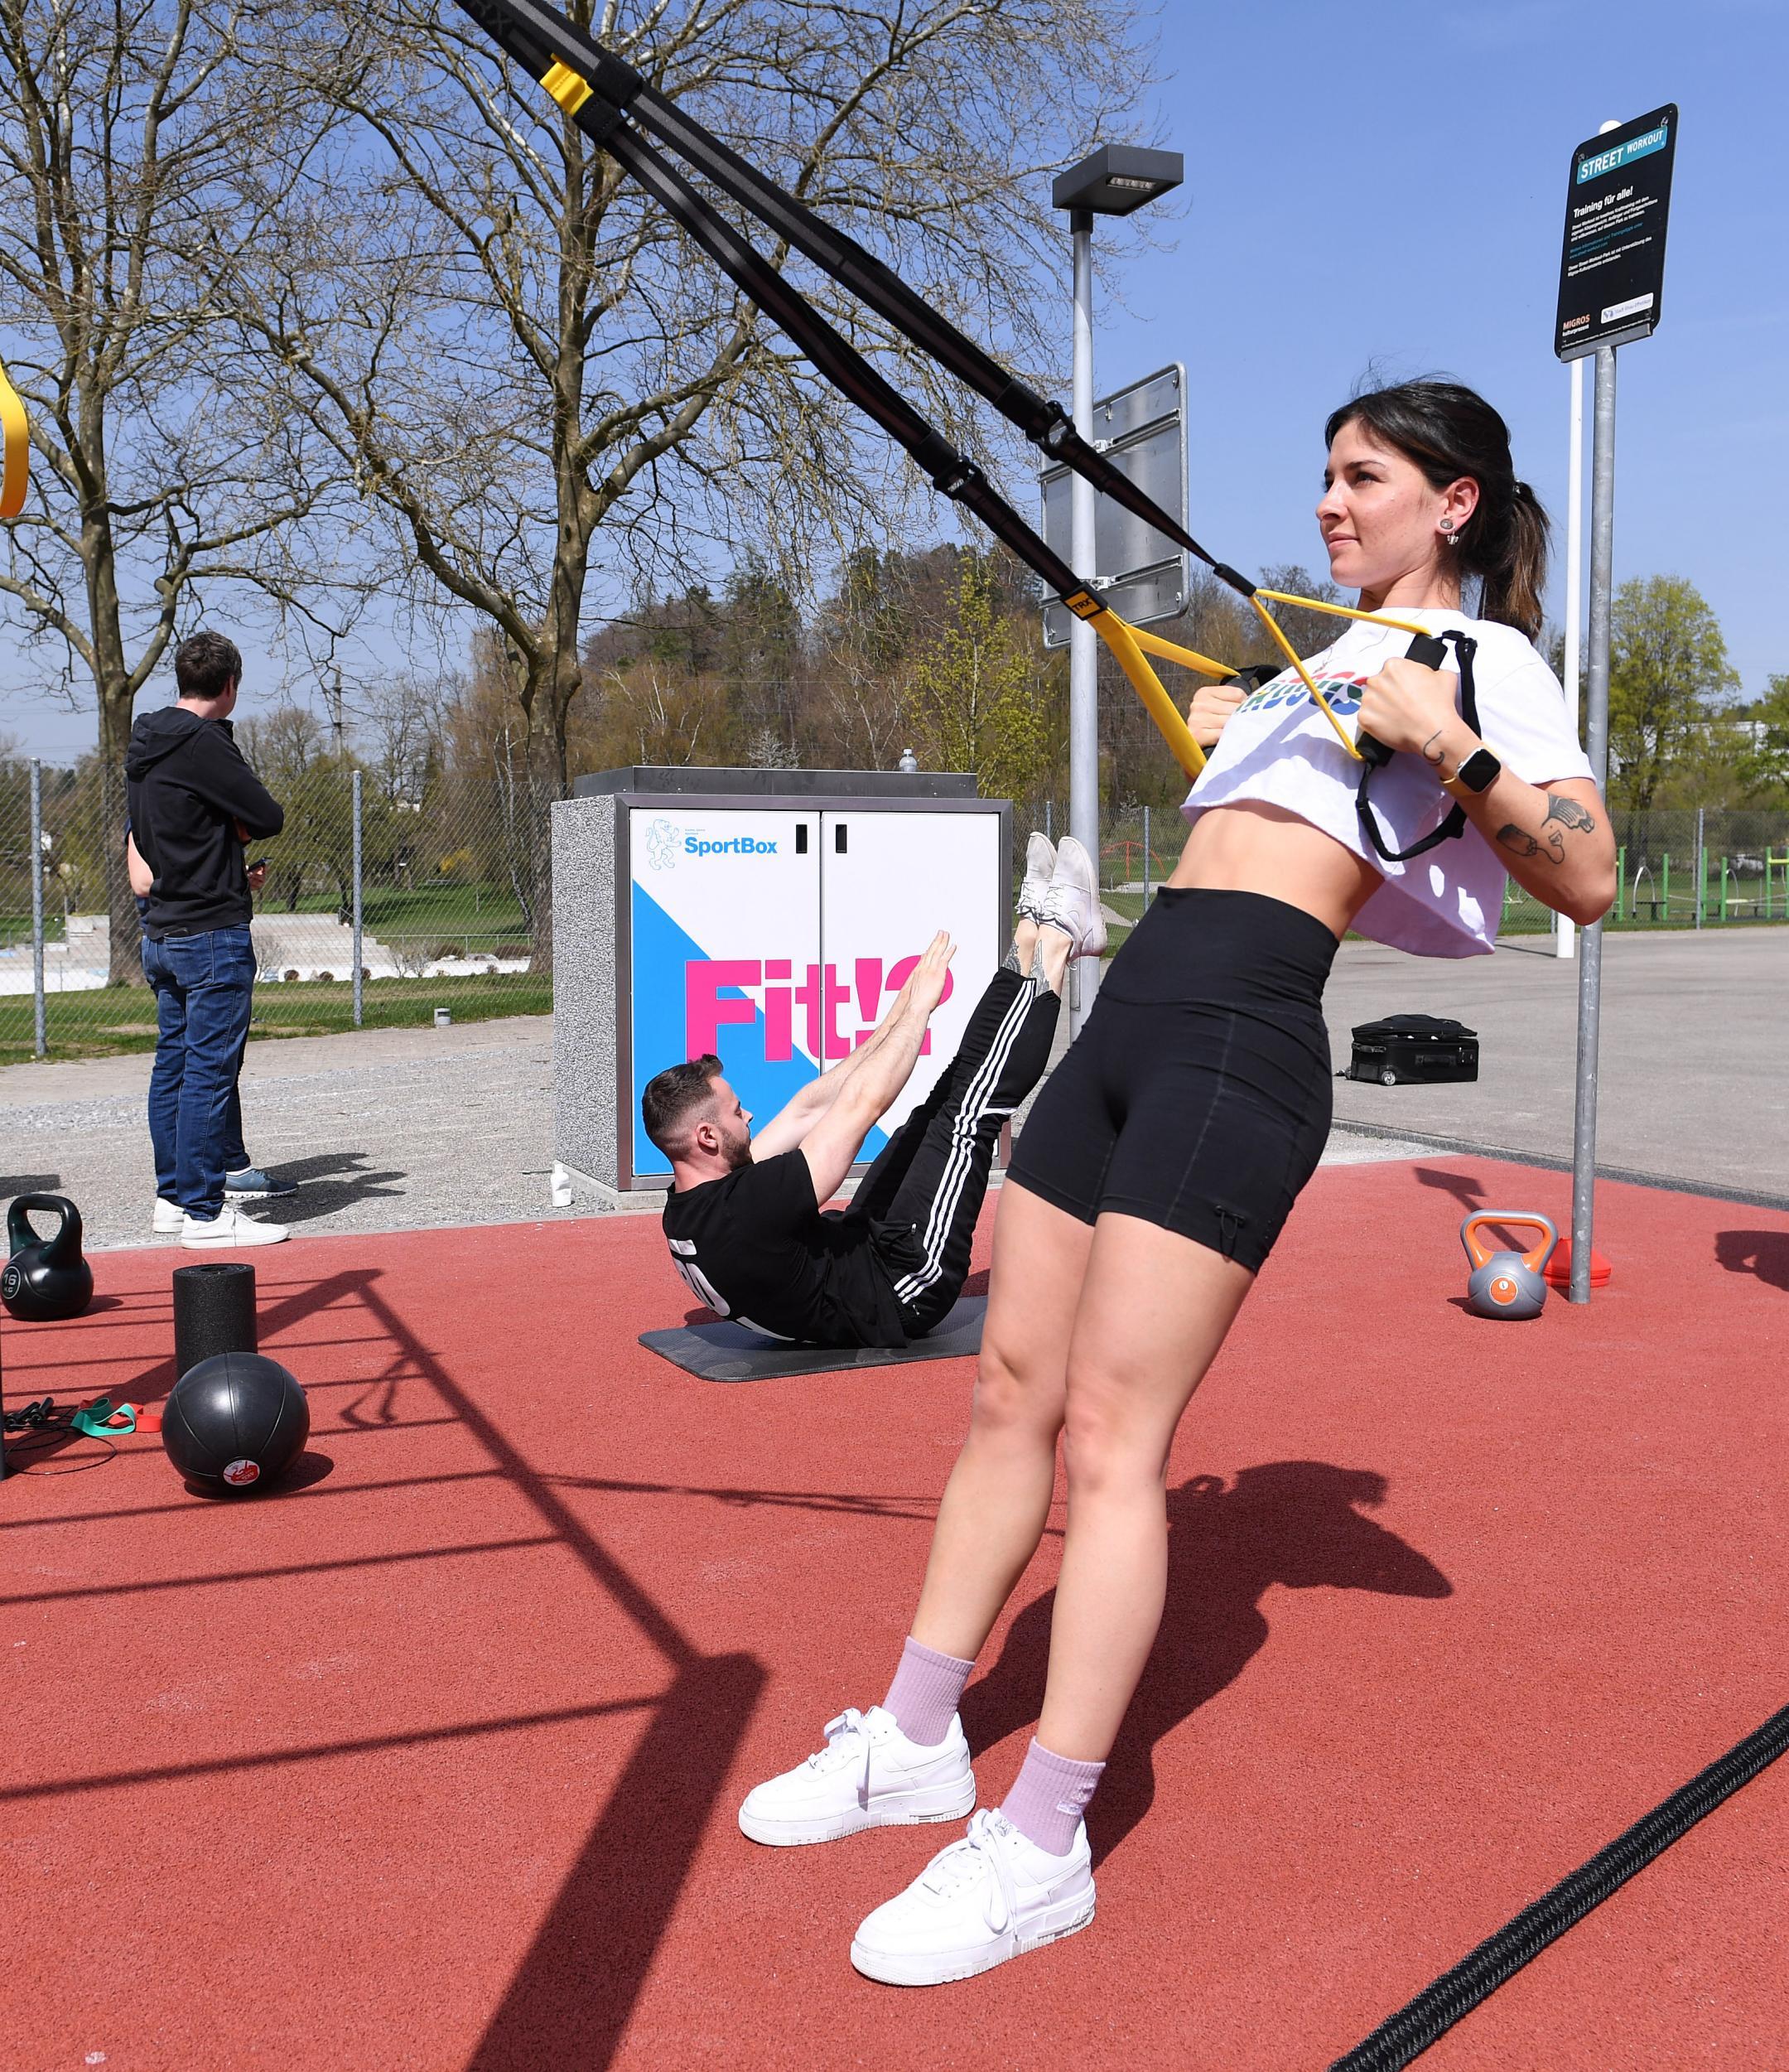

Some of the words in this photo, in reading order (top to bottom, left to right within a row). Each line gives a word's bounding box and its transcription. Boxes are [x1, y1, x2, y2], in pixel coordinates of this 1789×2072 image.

[1580, 147, 1624, 179] STREET
[1627, 129, 1664, 154] WORKOUT
[1573, 200, 1603, 219] Training
[1603, 194, 1616, 206] für
[1616, 186, 1633, 201] alle!
[1563, 314, 1590, 331] MIGROS
[1072, 598, 1092, 611] TRX
[685, 837, 778, 857] SportBox
[4, 1273, 17, 1285] 16
